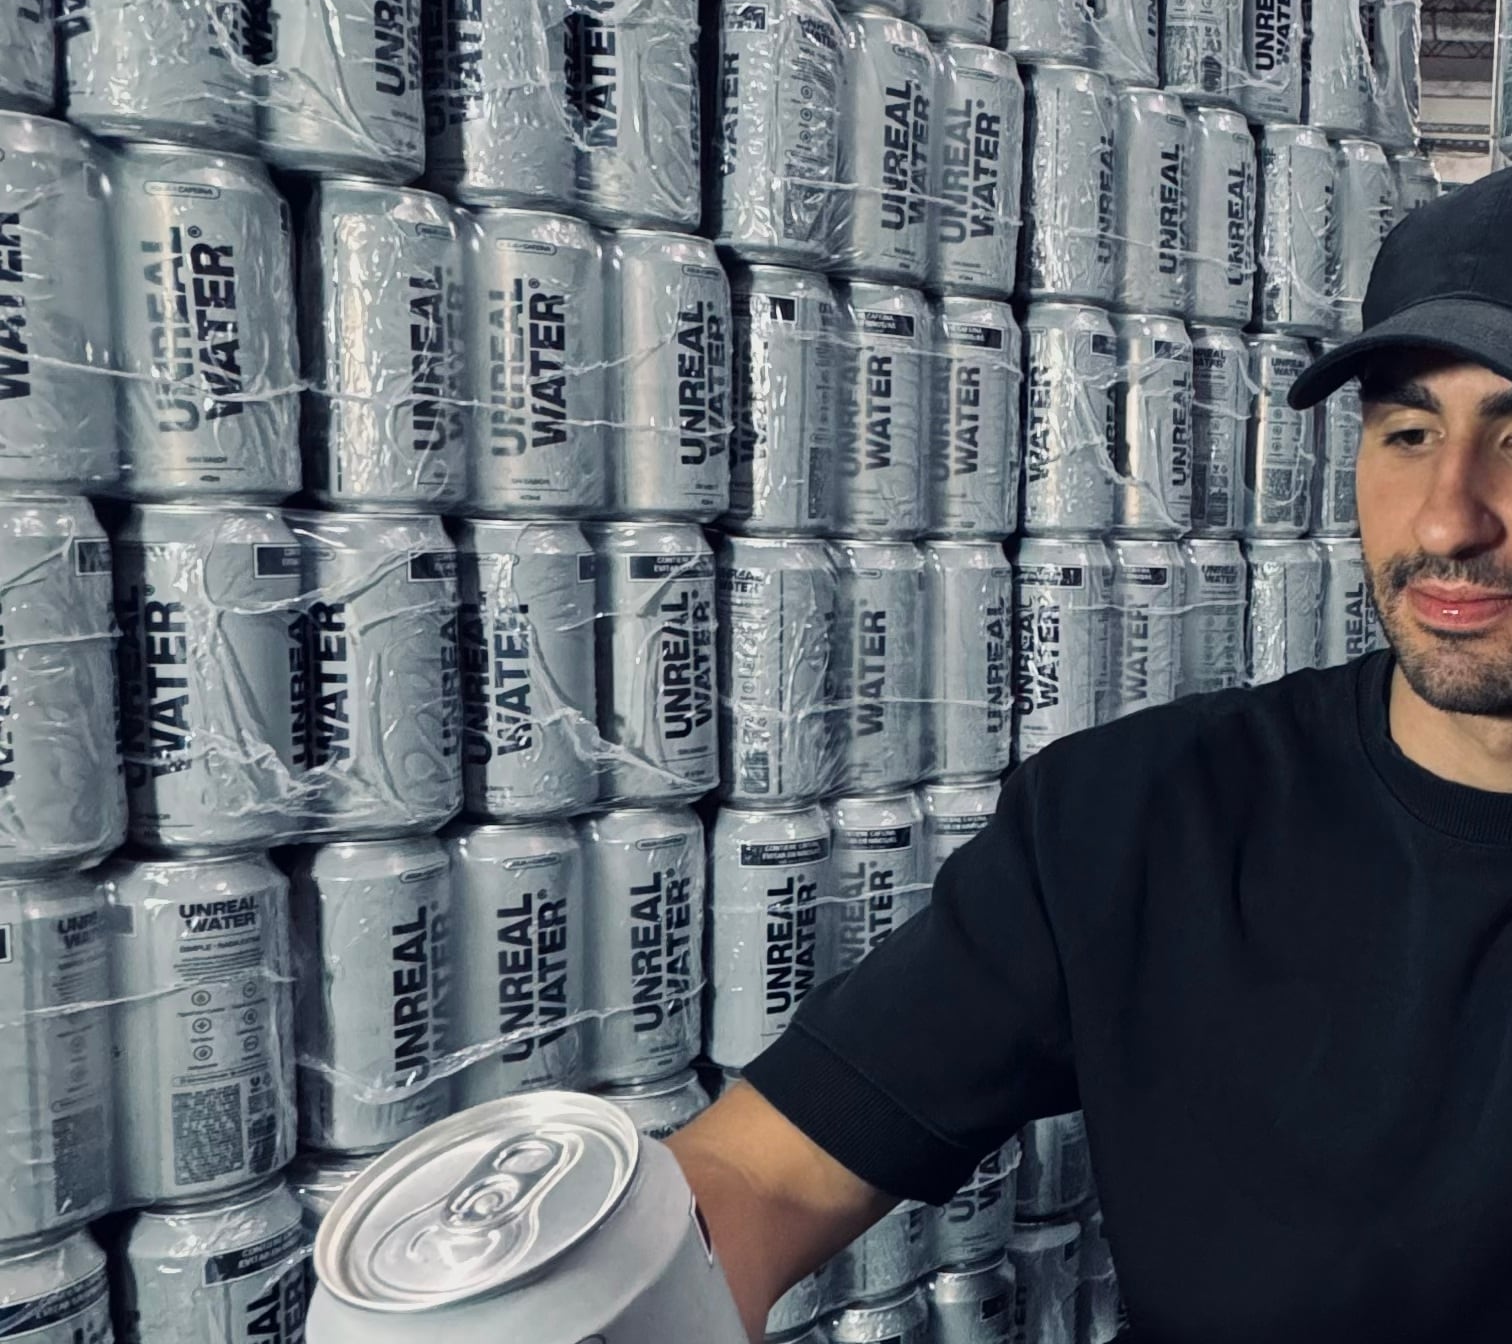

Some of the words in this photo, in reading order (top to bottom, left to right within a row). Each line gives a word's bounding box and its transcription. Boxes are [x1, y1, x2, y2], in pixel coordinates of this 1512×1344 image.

[882, 79, 912, 233] UNREAL
[940, 98, 973, 245] UNREAL
[971, 113, 1001, 238] WATER
[1159, 143, 1181, 275] UNREAL
[1228, 162, 1247, 286] UNREAL
[190, 243, 244, 422] WATER
[409, 266, 444, 452] UNREAL
[488, 278, 528, 457] UNREAL
[529, 292, 568, 448] WATER
[677, 300, 708, 465] UNREAL
[865, 354, 893, 470] WATER
[953, 366, 981, 475] WATER
[1171, 370, 1190, 487] UNREAL
[147, 601, 192, 777] WATER
[308, 603, 350, 759] WATER
[662, 591, 693, 739] UNREAL
[858, 611, 887, 737] WATER
[1124, 603, 1150, 703] WATER
[1344, 583, 1364, 656] REAL
[179, 894, 258, 922] UNREAL
[186, 913, 257, 935] WATER
[497, 894, 535, 1063] UNREAL
[536, 898, 569, 1048] WATER
[630, 871, 663, 1033] UNREAL
[665, 878, 691, 1017] WATER
[766, 877, 795, 1014] UNREAL
[869, 869, 894, 947] ATER
[393, 906, 430, 1089] UNREAL
